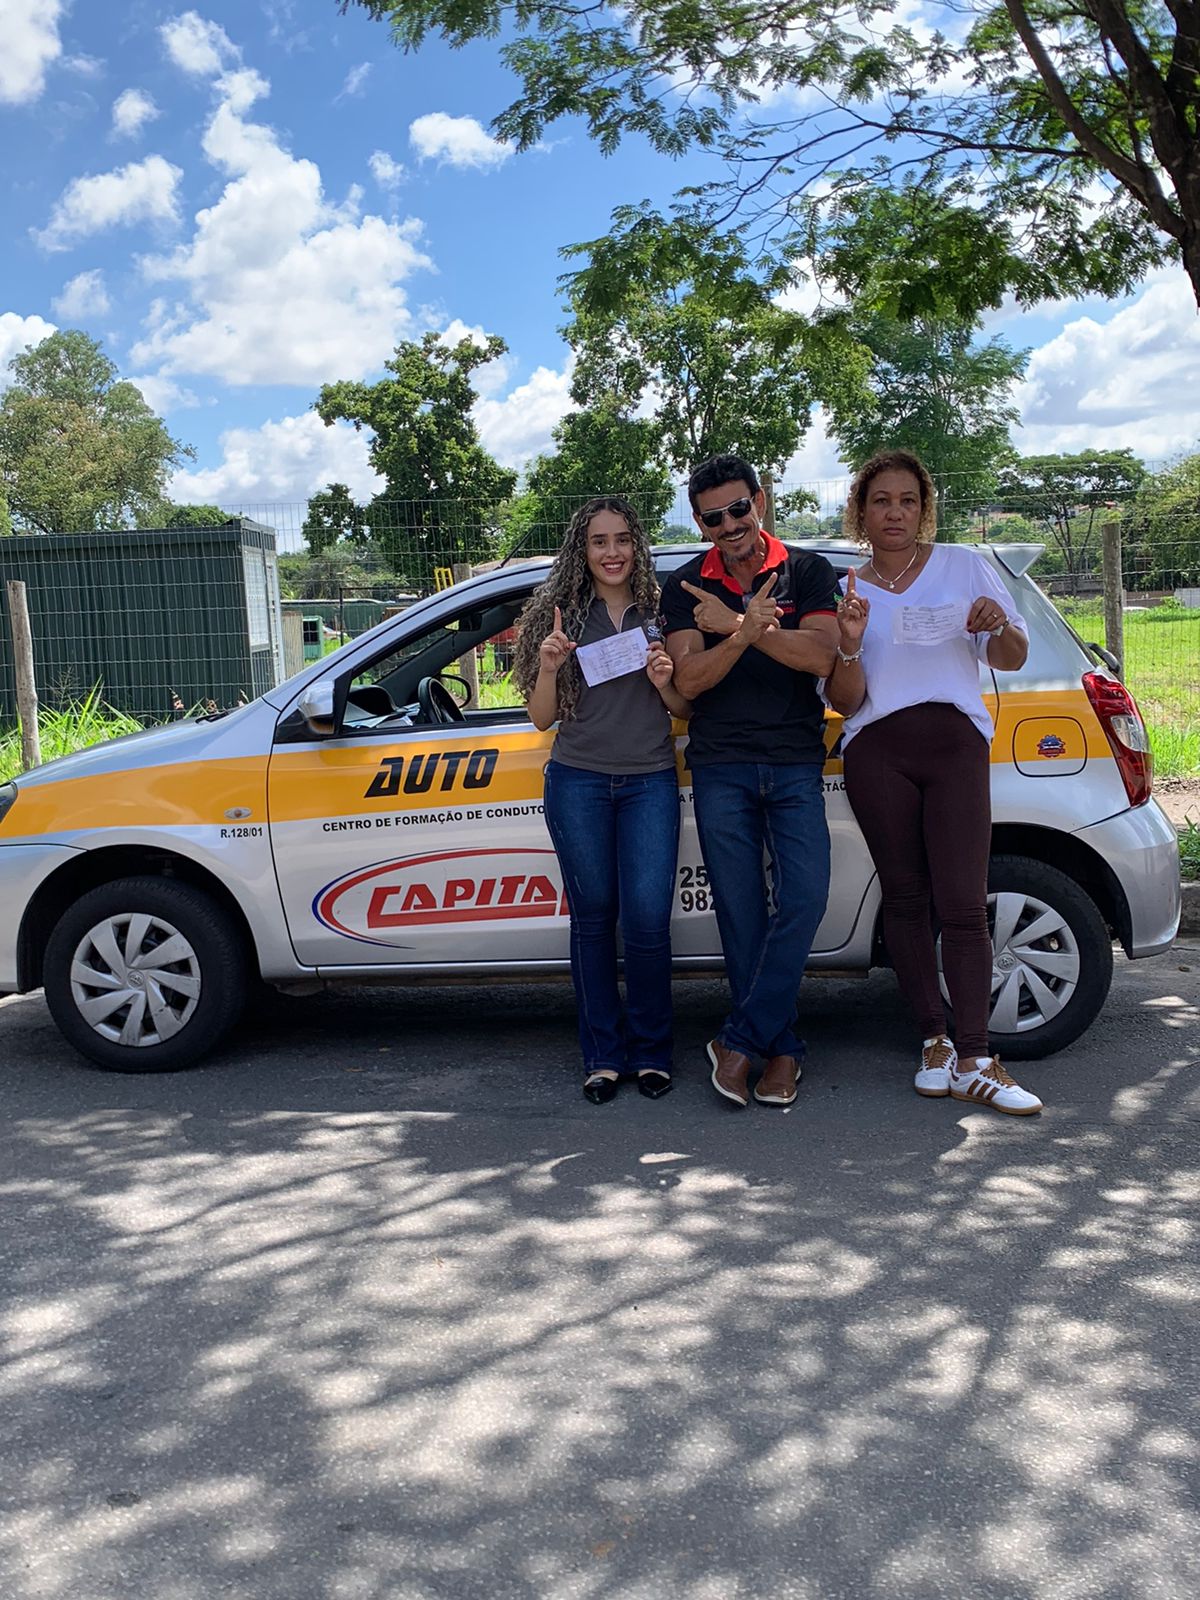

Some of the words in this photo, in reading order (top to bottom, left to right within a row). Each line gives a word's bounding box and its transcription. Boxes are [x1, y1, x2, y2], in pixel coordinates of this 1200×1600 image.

[364, 748, 500, 798] AUTO
[322, 819, 372, 832] CENTRO
[375, 817, 391, 828] DE
[395, 810, 463, 826] FORMAÇÃO
[466, 810, 483, 820] DE
[220, 827, 263, 838] R.128/01
